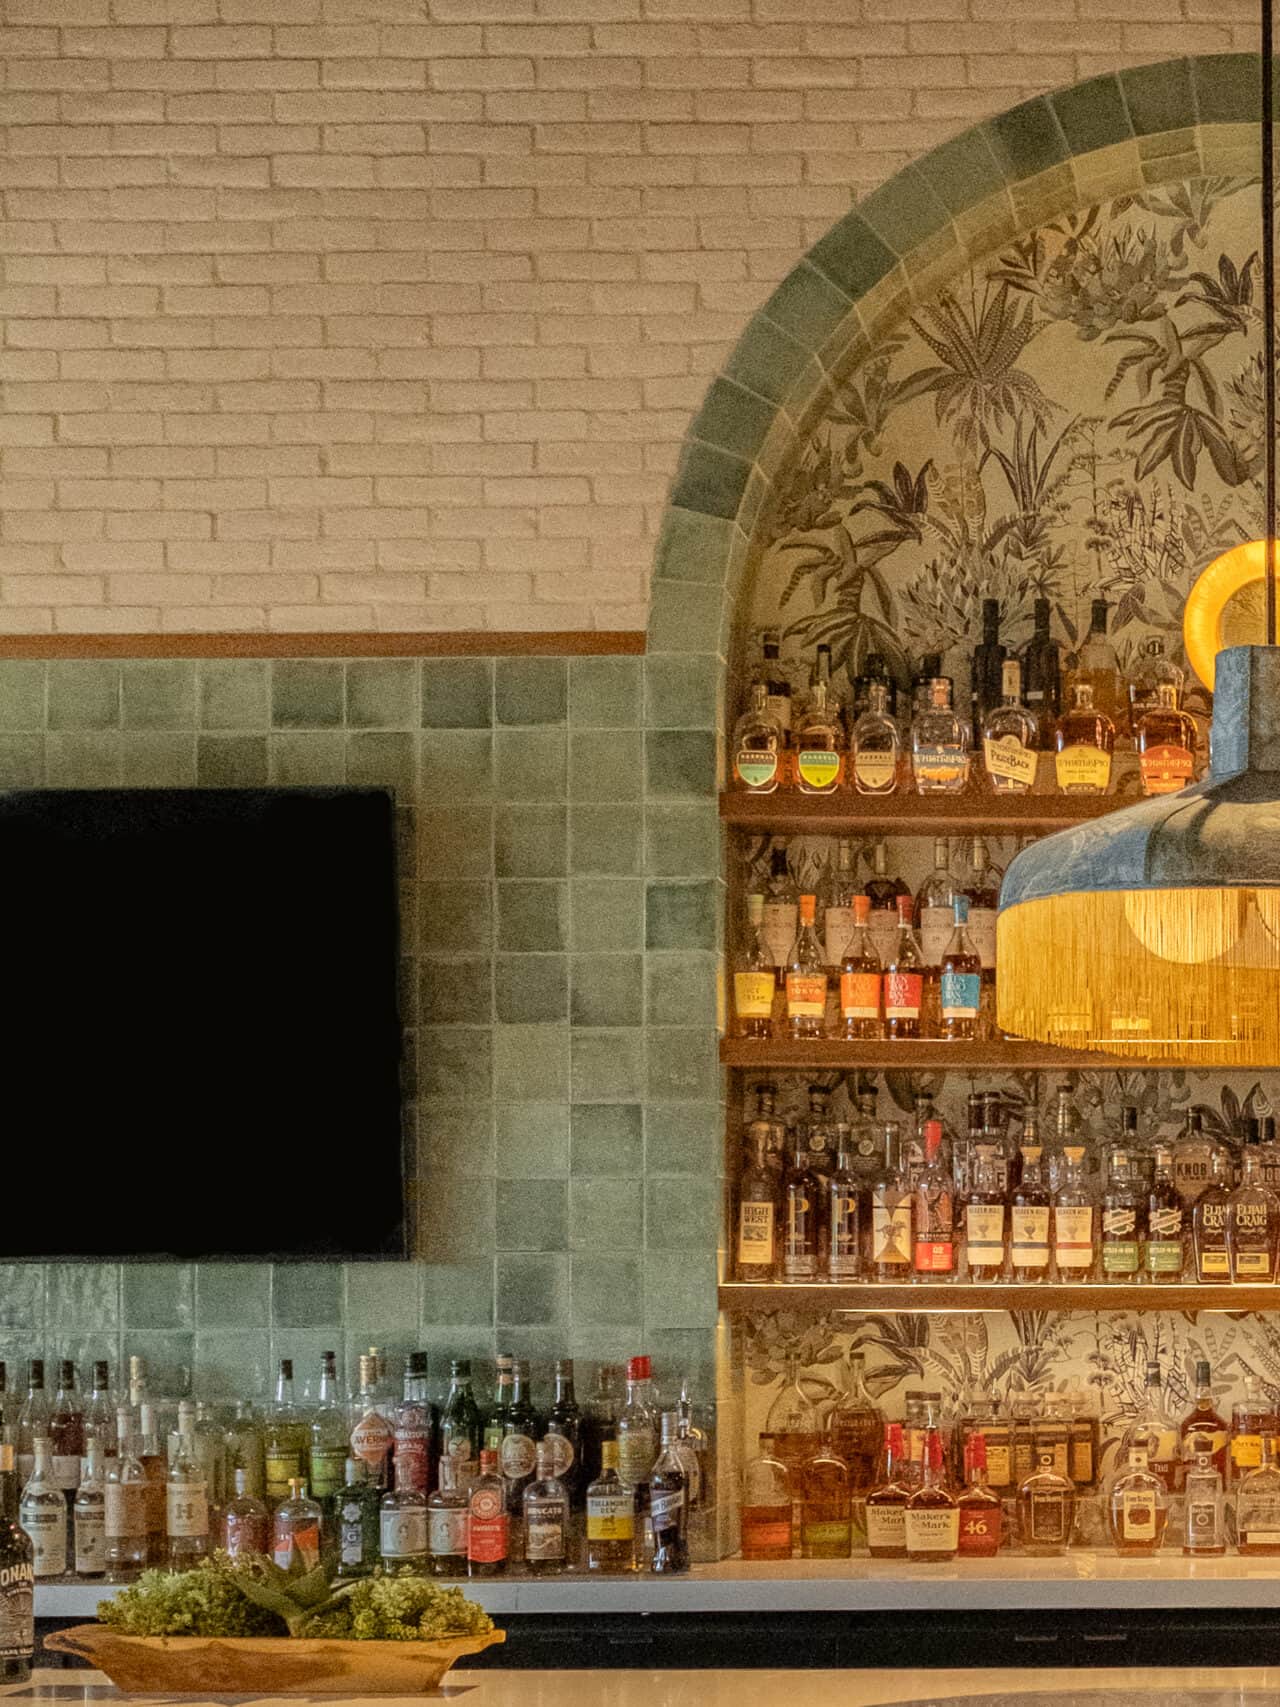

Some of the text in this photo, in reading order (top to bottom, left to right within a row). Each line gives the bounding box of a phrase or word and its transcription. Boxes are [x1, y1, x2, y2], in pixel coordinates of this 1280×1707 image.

[1177, 1163, 1206, 1176] KNOB
[1203, 1204, 1227, 1216] ELIJA
[1236, 1204, 1267, 1216] ELIJAH
[1203, 1216, 1225, 1227] CRA
[1236, 1216, 1267, 1227] CRAIG
[871, 1508, 905, 1517] Maker
[911, 1513, 951, 1521] Maker's
[965, 1519, 988, 1535] 46
